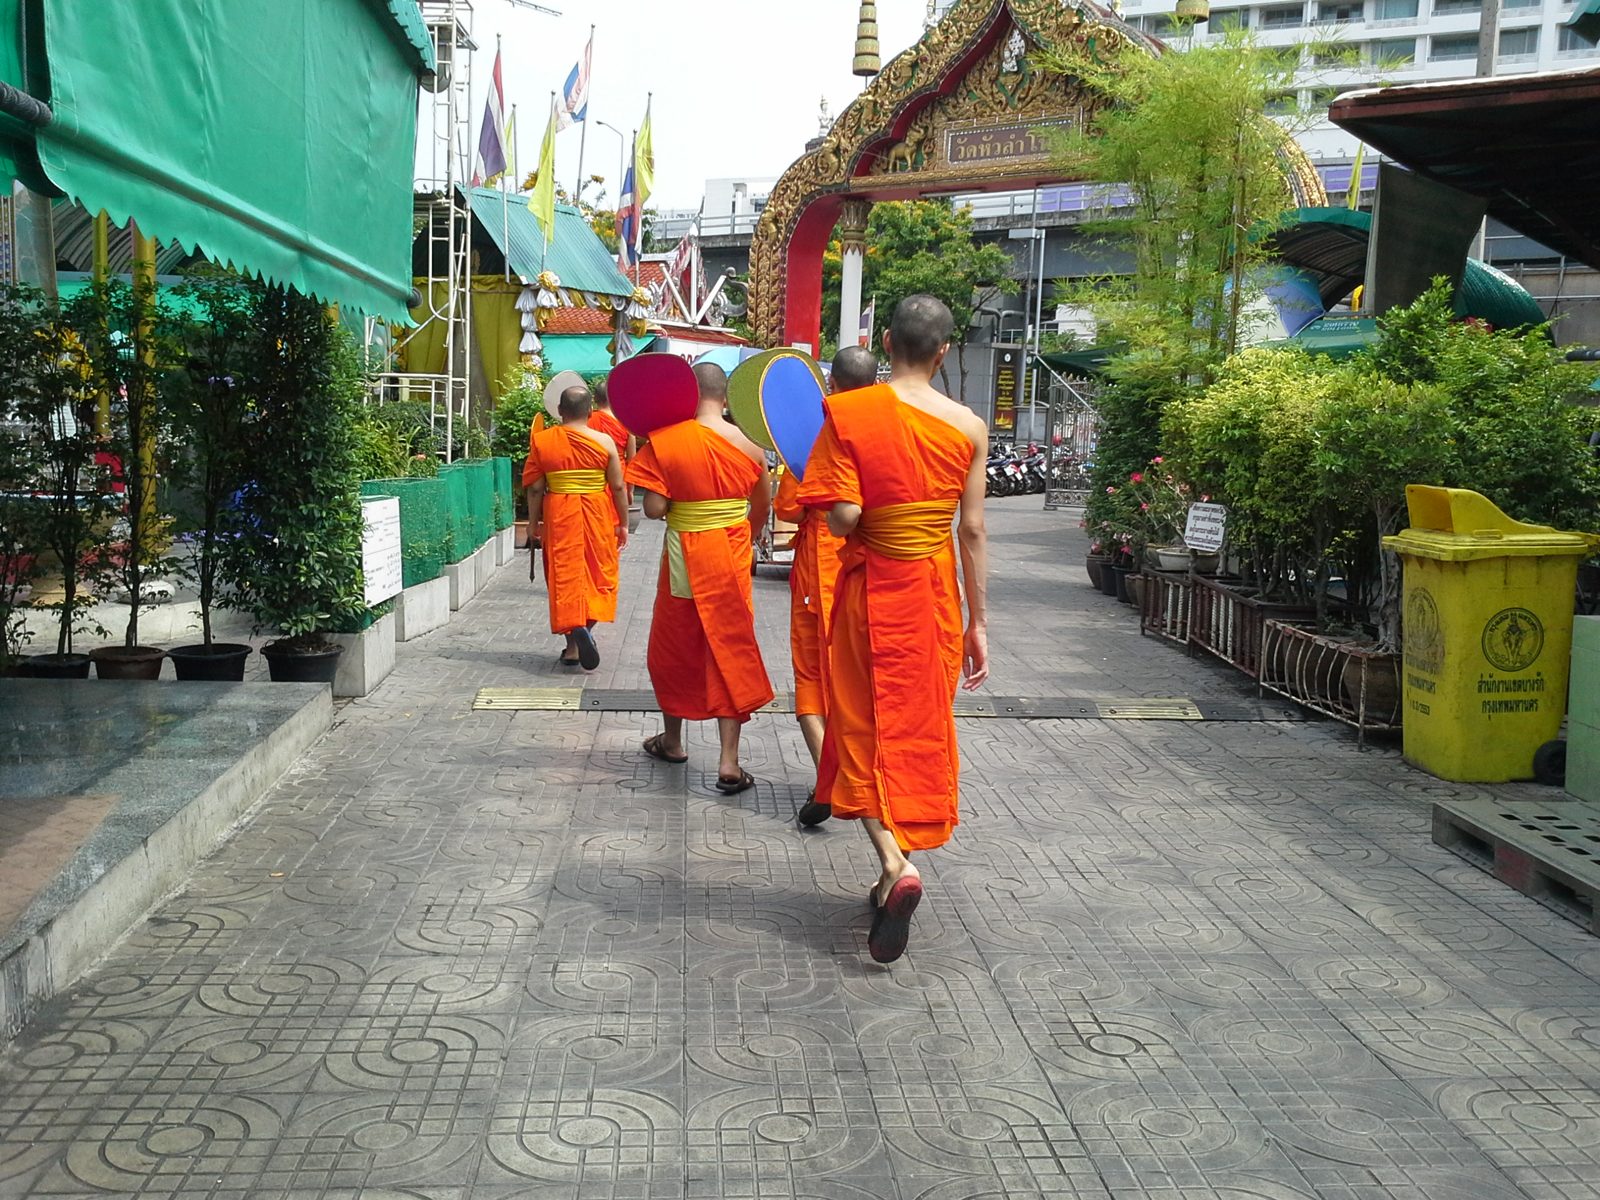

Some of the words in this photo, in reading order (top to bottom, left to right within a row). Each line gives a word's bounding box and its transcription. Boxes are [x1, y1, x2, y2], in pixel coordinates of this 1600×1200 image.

[956, 130, 1051, 160] วัดหัวลำโ
[1481, 699, 1539, 721] กรุงเทพมหานคร
